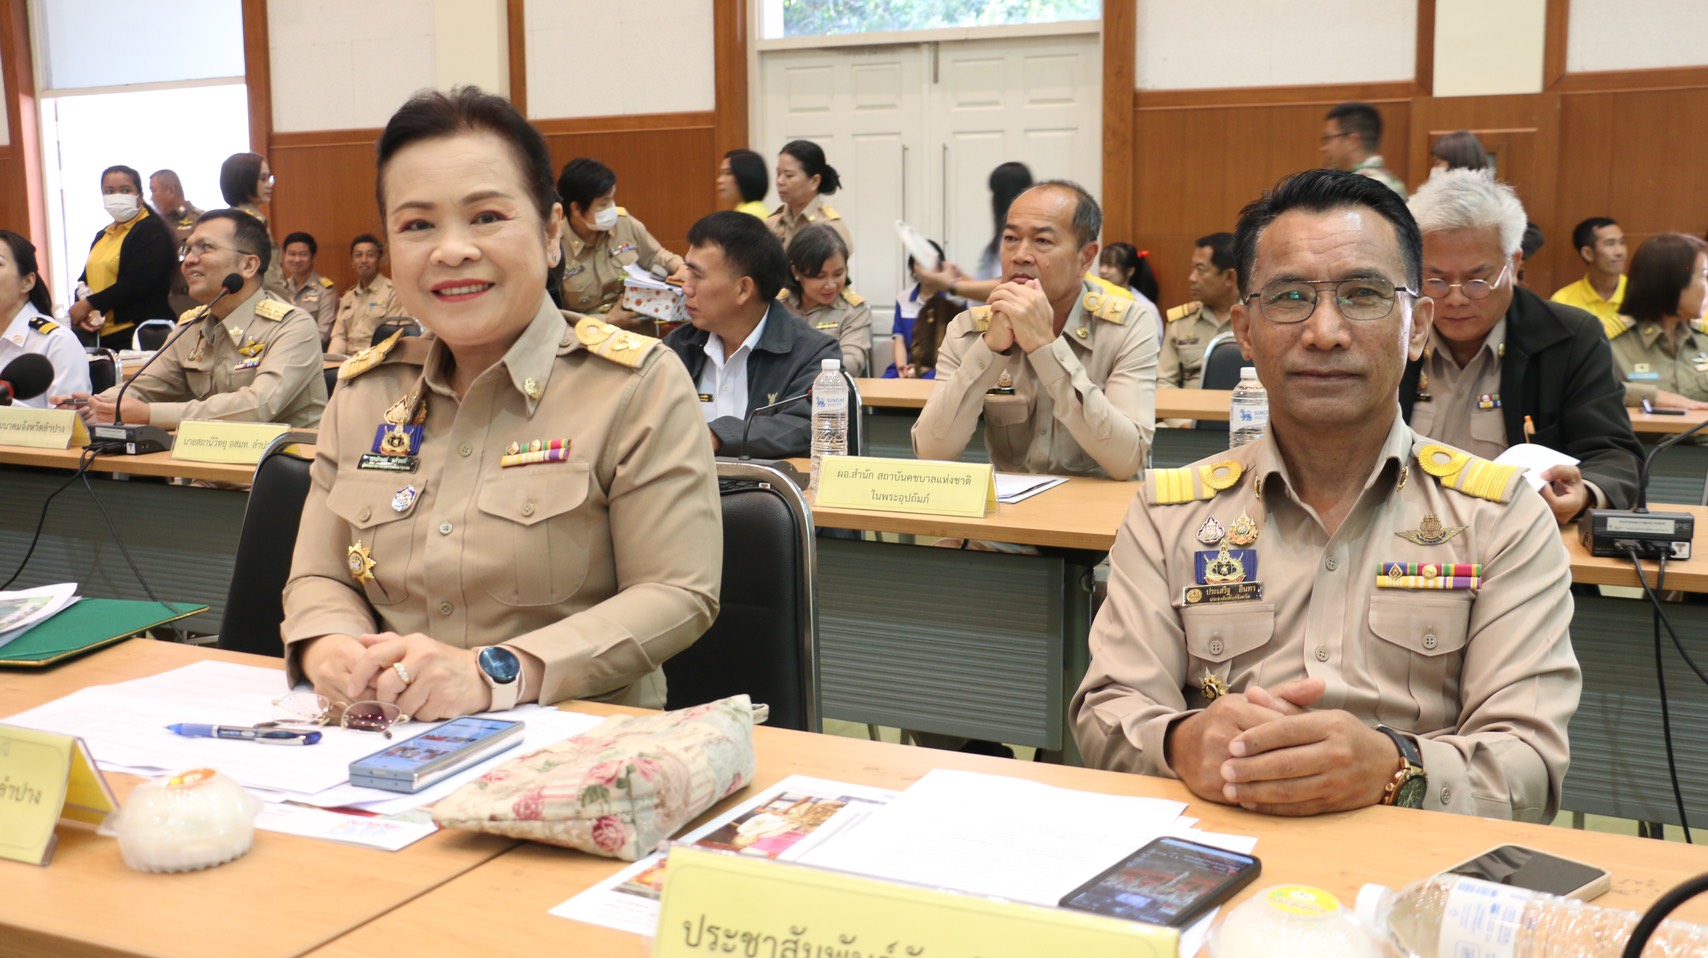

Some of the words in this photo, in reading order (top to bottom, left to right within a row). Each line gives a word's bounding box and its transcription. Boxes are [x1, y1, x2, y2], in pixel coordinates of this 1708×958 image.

[837, 468, 874, 480] ผอ.สำนัก
[877, 470, 972, 486] สถาบันคชบาลแห่งชาติ
[871, 489, 930, 505] ในพระอุปถัมภ์
